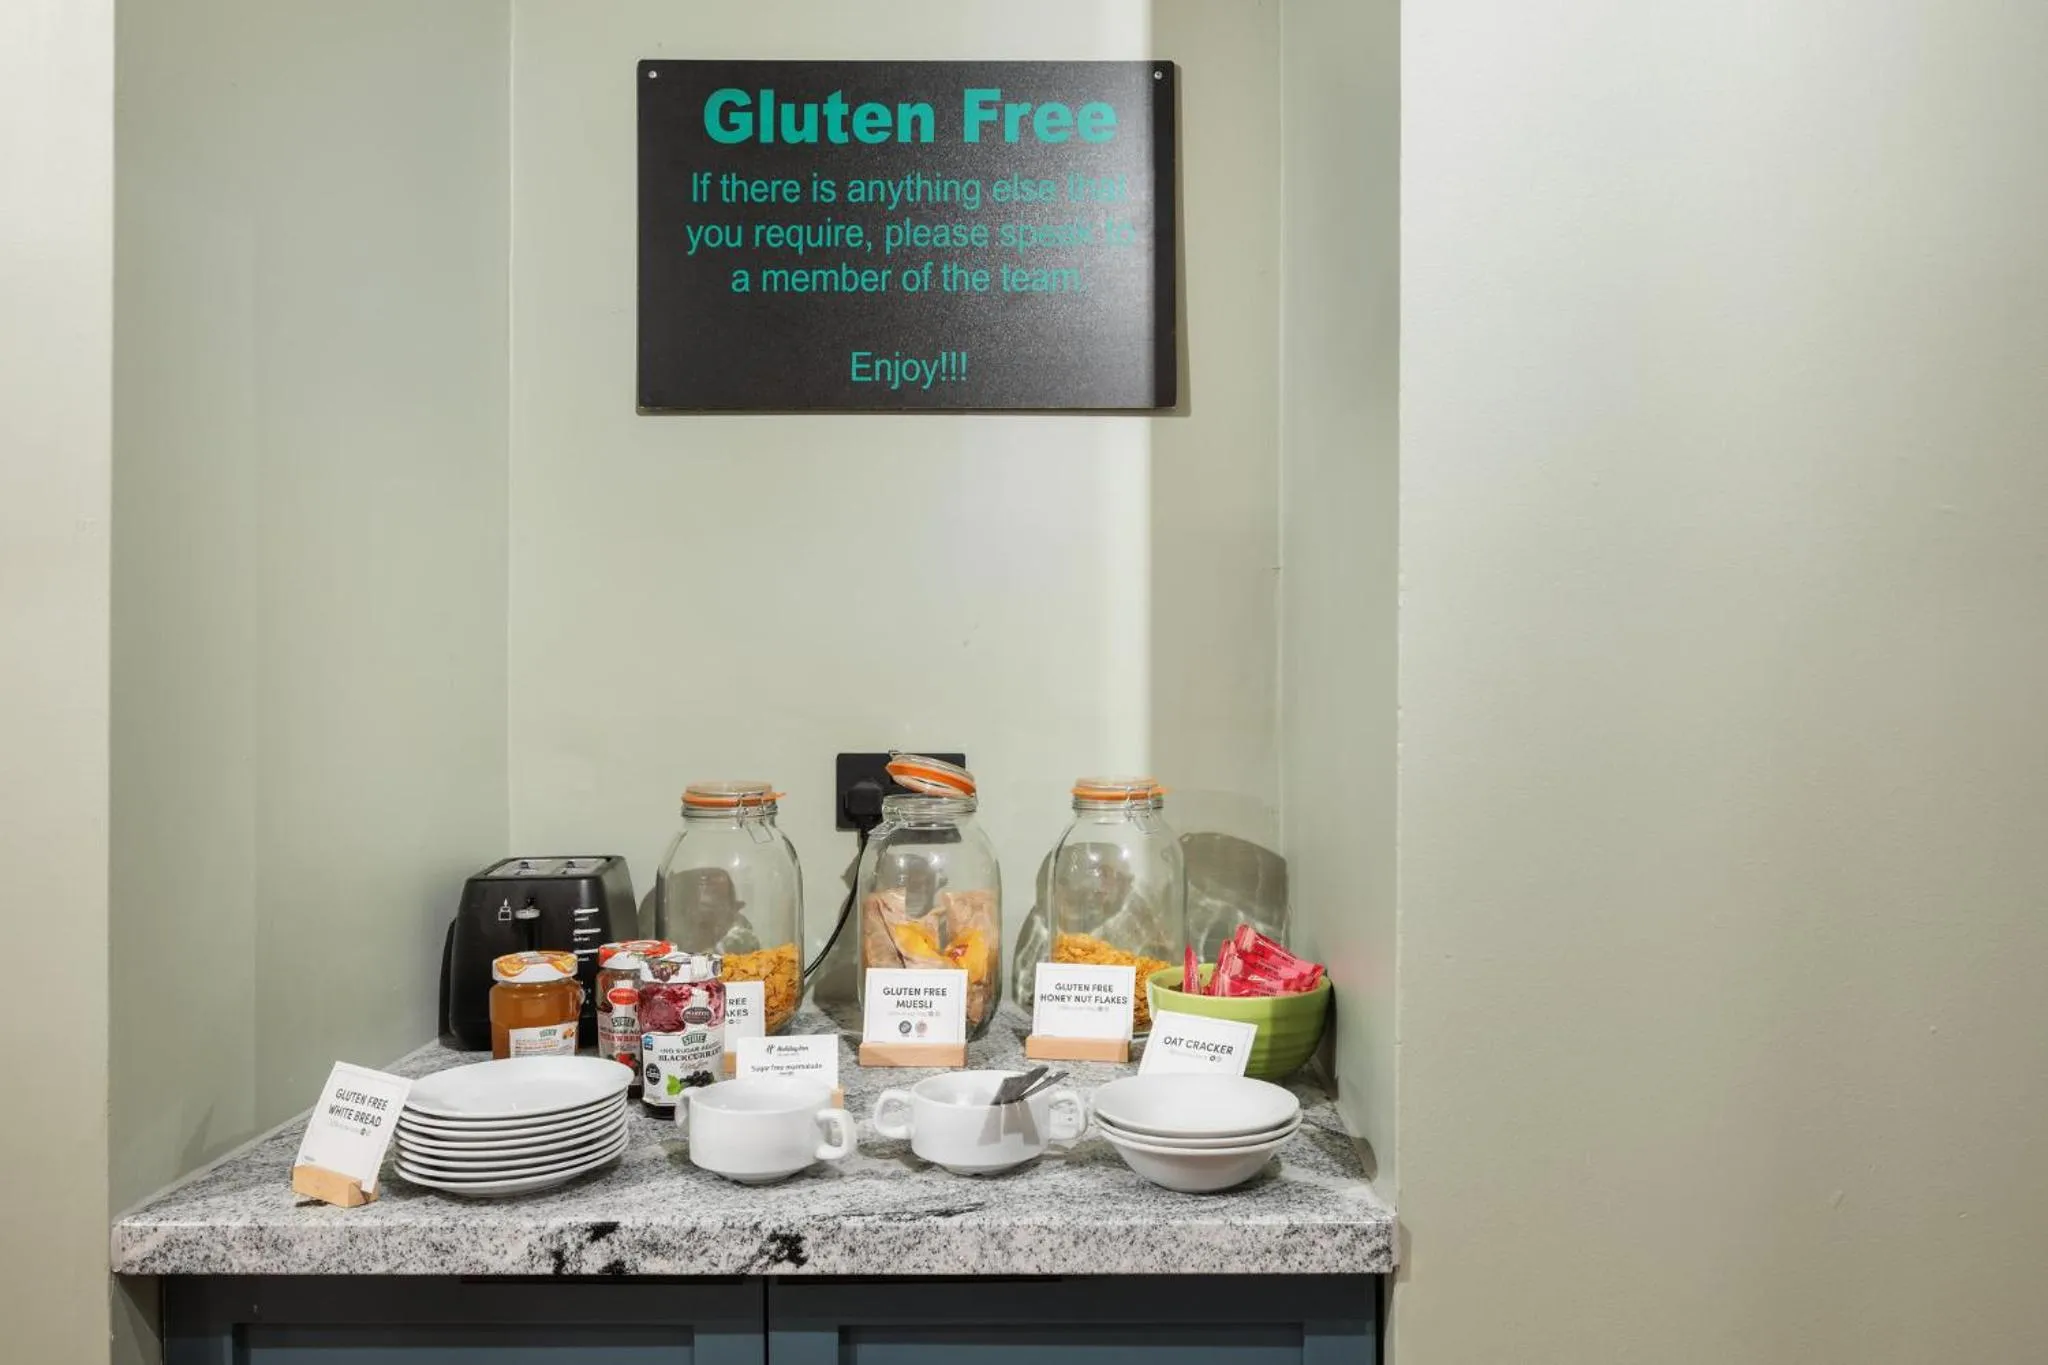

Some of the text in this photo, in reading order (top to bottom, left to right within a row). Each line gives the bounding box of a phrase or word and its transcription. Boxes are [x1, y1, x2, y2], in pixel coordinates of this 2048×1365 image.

[703, 87, 1120, 145] Gluten Free
[691, 170, 1127, 212] If there is anything else that
[686, 217, 1137, 257] you require, please speak to
[730, 269, 753, 295] a
[761, 262, 893, 296] member
[901, 261, 935, 296] of
[942, 261, 991, 295] the
[850, 348, 970, 392] Enjoy!!!
[882, 987, 947, 996] GLUTEN FREE
[1055, 982, 1114, 993] GLUTEN FREE
[729, 997, 747, 1006] REE
[895, 999, 933, 1009] MUESLI
[1040, 993, 1128, 1005] HONEY NUT FLAKES
[1163, 1036, 1234, 1055] OAT CRACKER
[751, 1065, 769, 1073] Sugar
[785, 1062, 823, 1071] marmalade
[335, 1087, 389, 1112] GLUTEN FREE
[328, 1104, 353, 1121] WHITE
[353, 1109, 382, 1127] BREAD
